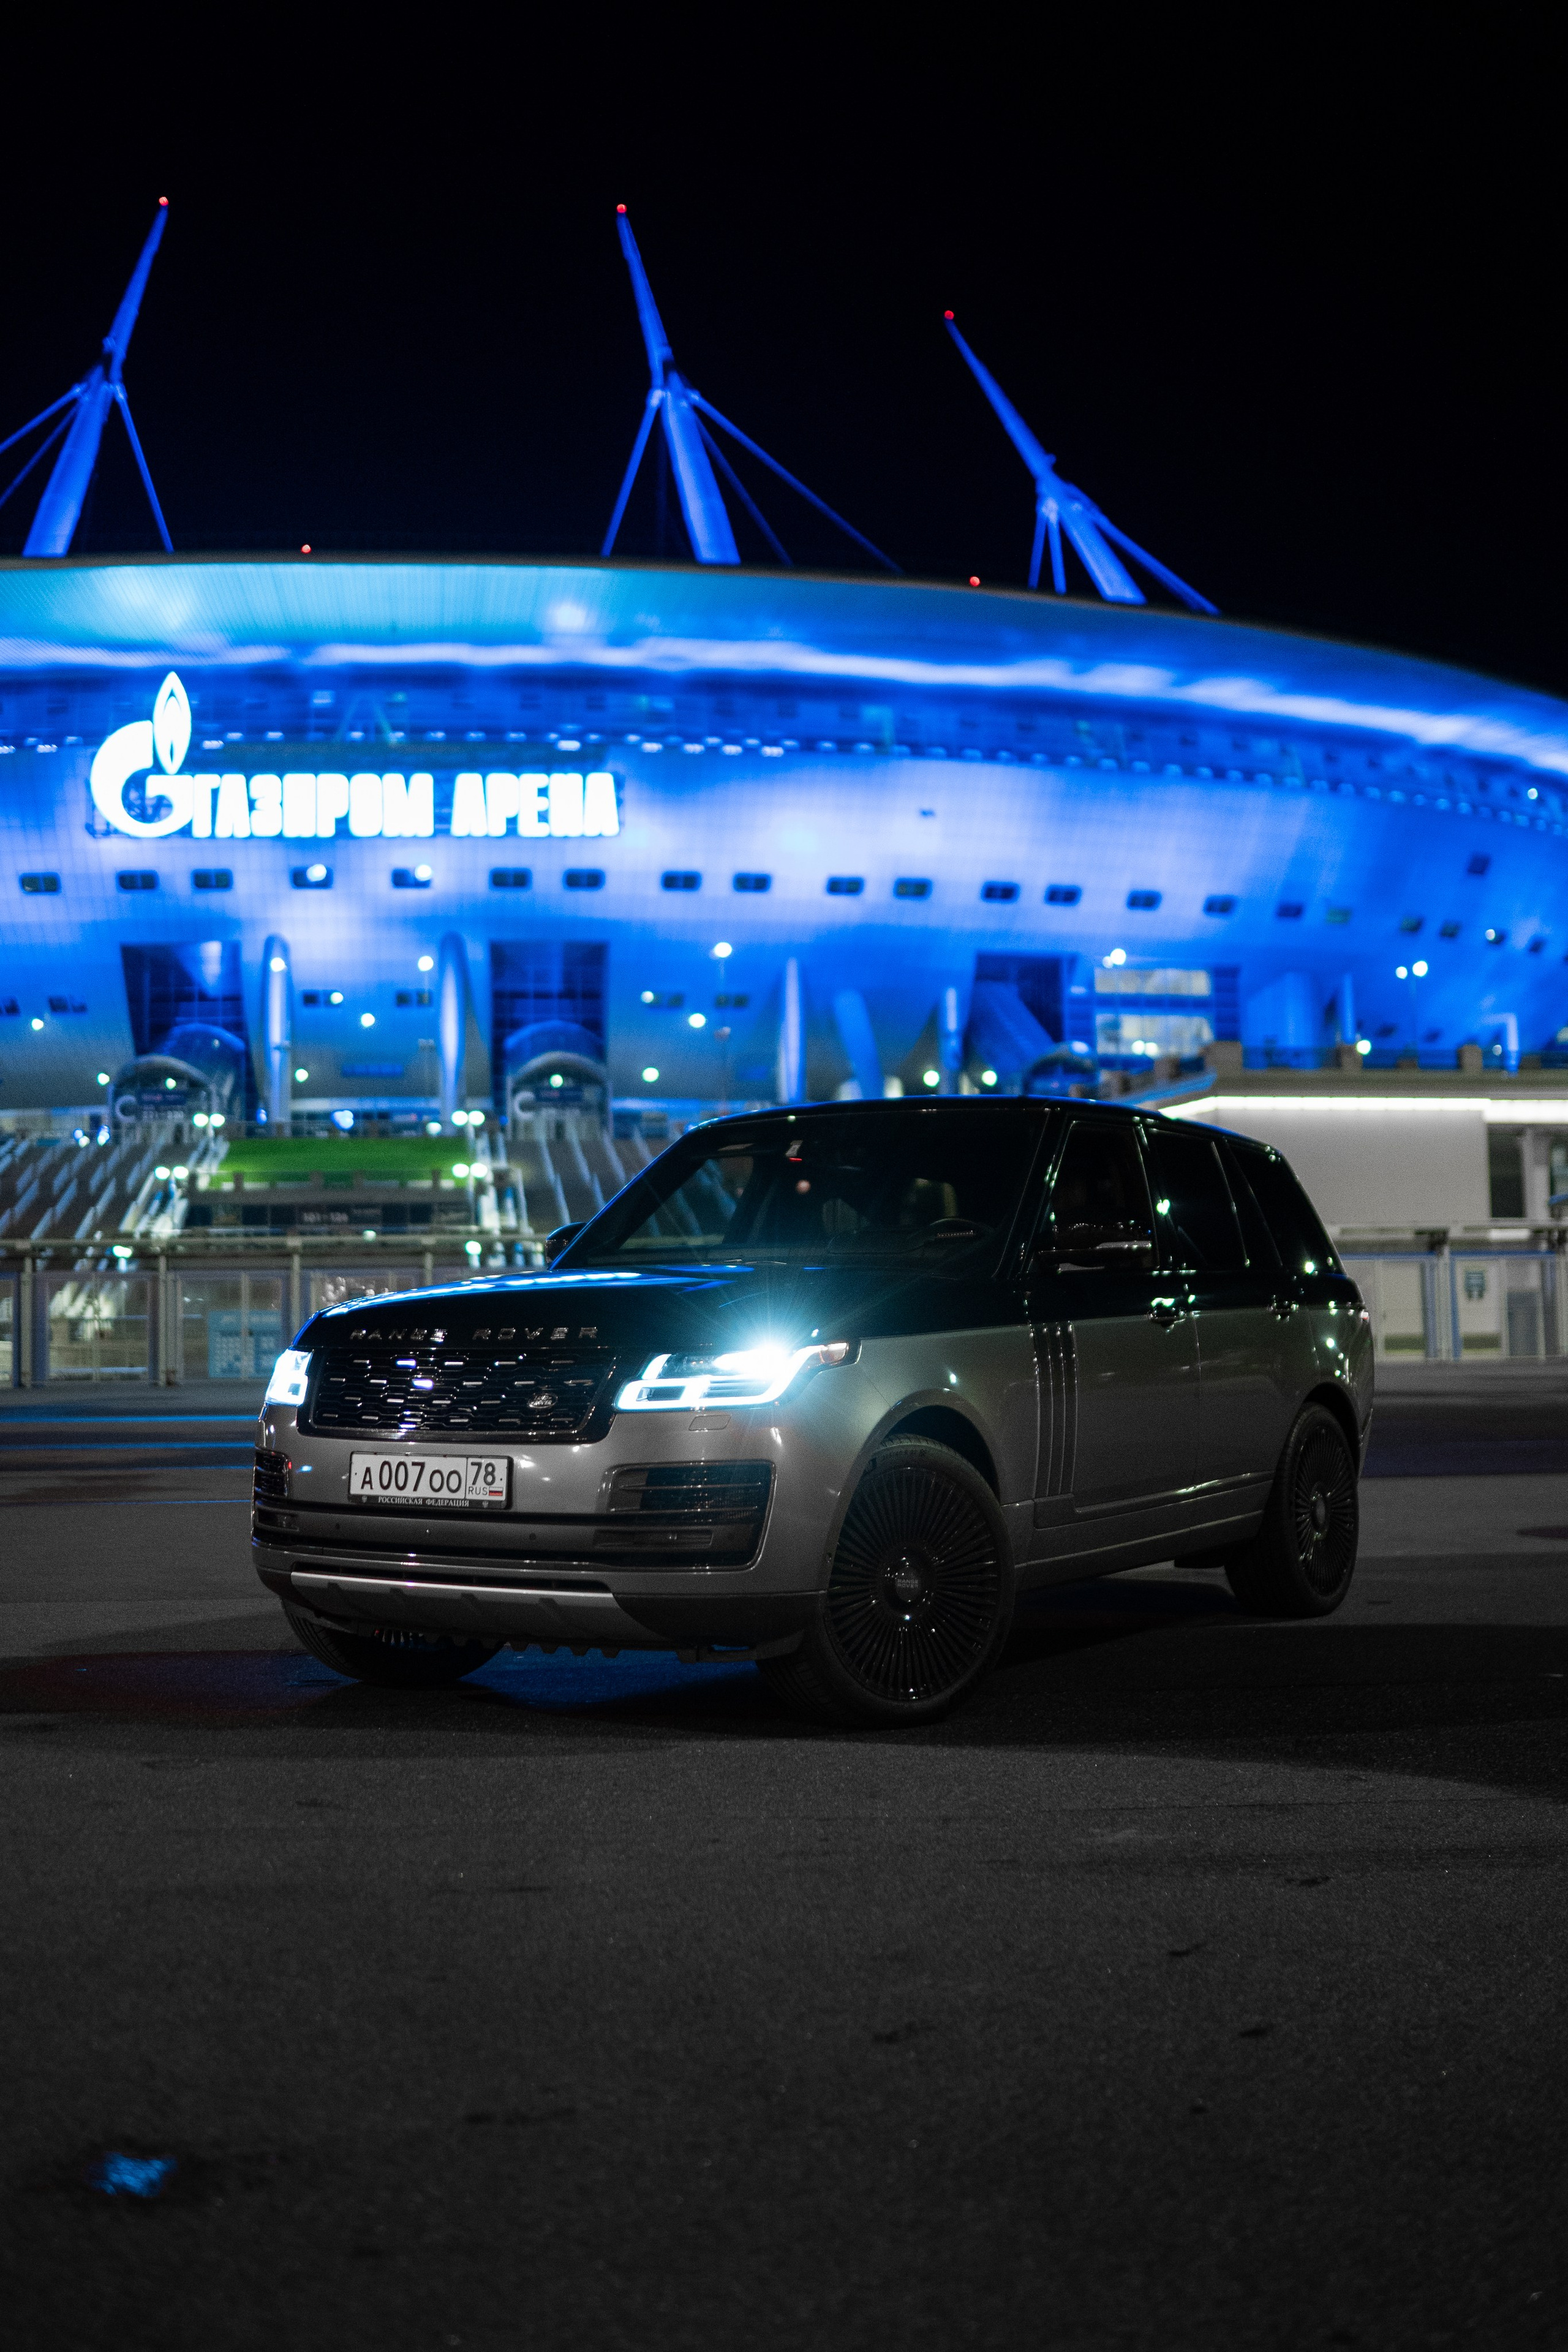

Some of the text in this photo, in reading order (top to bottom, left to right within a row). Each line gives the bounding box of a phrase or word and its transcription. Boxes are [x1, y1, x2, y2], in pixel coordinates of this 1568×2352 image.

[191, 772, 620, 839] ГАЗПРОМ АРЕНА
[350, 1327, 598, 1342] RANGE ROVER
[470, 1461, 496, 1486] 78
[468, 1486, 488, 1496] RUS
[378, 1496, 469, 1507] РОССИЙСКАЯ ФЕДЕРАЦИЯ
